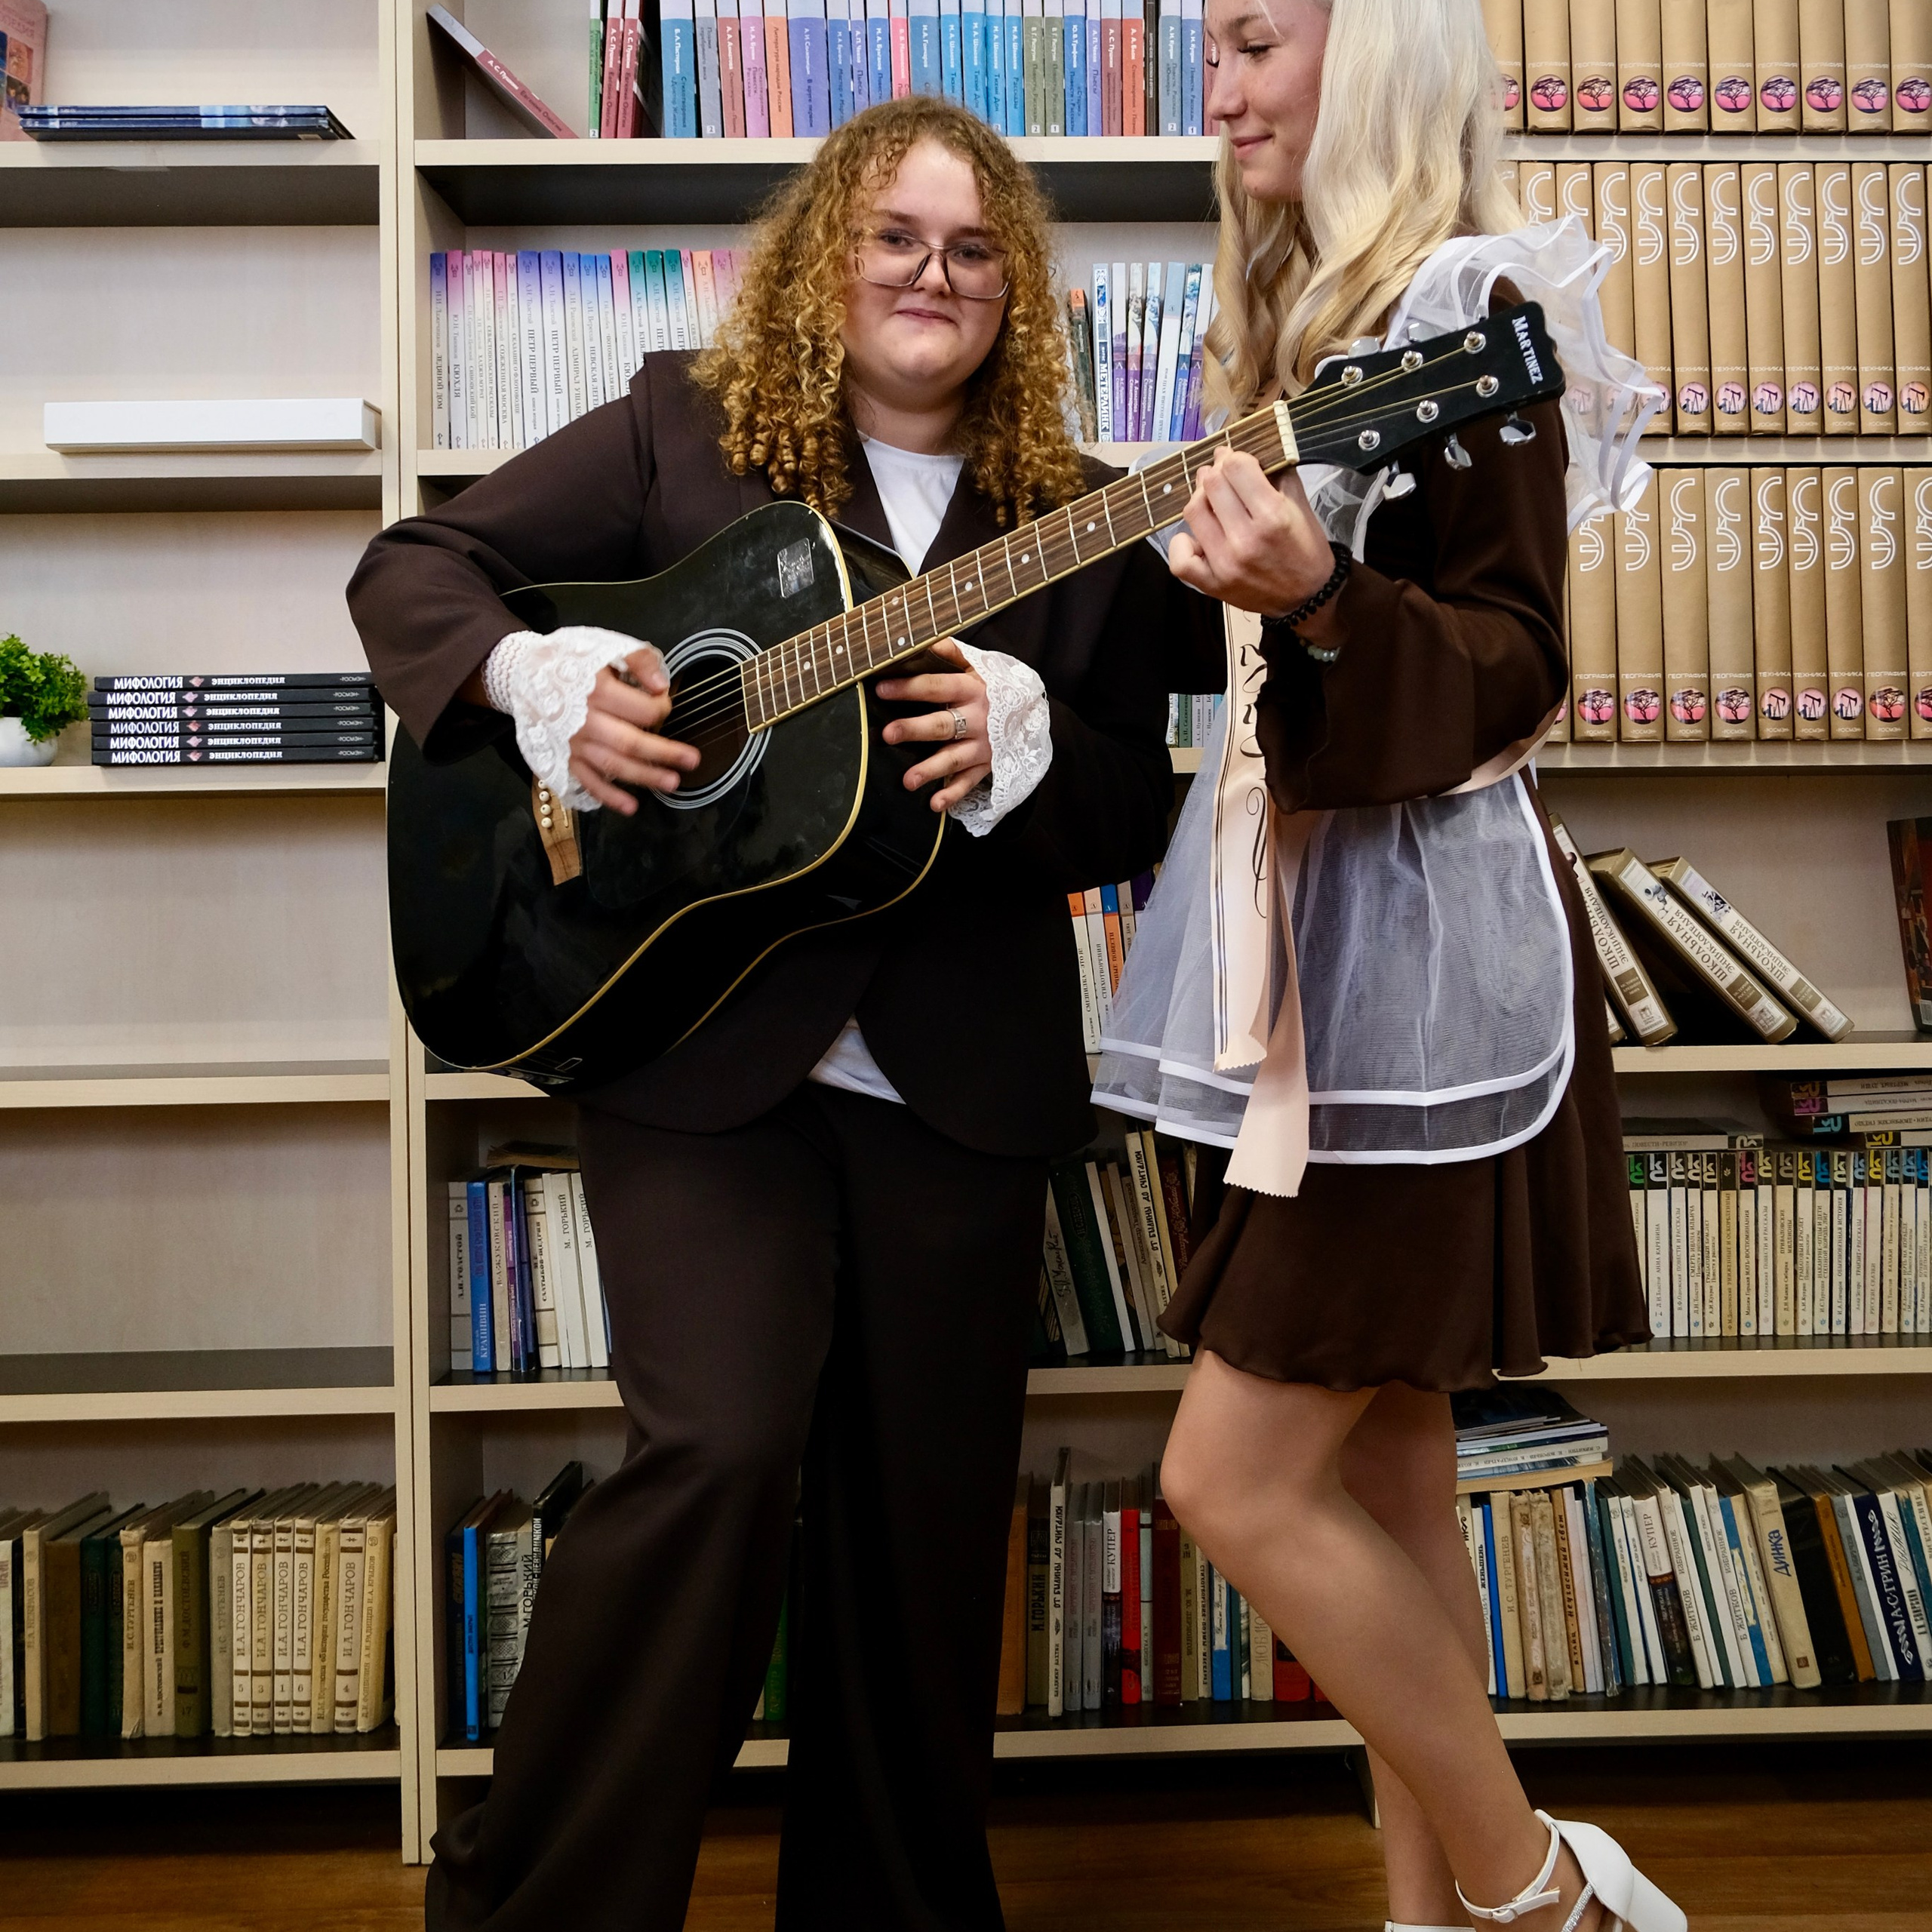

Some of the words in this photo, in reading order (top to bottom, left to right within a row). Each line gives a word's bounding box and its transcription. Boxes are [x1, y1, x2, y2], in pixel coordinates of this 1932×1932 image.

[528, 329, 537, 352] ПЕТР
[551, 330, 560, 353] ПЕТР
[1512, 315, 1543, 385] MARTINEZ
[453, 364, 461, 398] КЮХЛЯ
[499, 344, 507, 392] СОЖЖЕННАЯ
[528, 354, 538, 394] ПЕРВЫЙ
[552, 355, 563, 394] ПЕРВЫЙ
[572, 346, 580, 384] АДМИРАЛ
[589, 346, 598, 383] НЕВСКАЯ
[1100, 363, 1109, 429] МЕТЕРЛИНК
[106, 692, 176, 704] МИФОЛОГИЯ
[204, 692, 278, 701] ЭНЦИКЛОПЕДИЯ
[114, 677, 183, 690] МИФОЛОГИЯ
[211, 677, 285, 685] ЭНЦИКЛОПЕДИЯ
[108, 708, 177, 719] МИФОЛОГИЯ
[206, 707, 280, 715] ЭНЦИКЛОПЕДИЯ
[110, 721, 180, 734] МИФОЛОГИЯ
[208, 721, 281, 730] ЭНЦИКЛОПЕДИЯ
[109, 737, 179, 749] МИФОЛОГИЯ
[208, 737, 281, 746] ЭНЦИКЛОПЕДИЯ
[111, 751, 180, 764] МИФОЛОГИЯ
[209, 751, 283, 759] ЭНЦИКЛОПЕДИЯ
[1584, 886, 1629, 964] ЭНЦИКЛОПЕДИЯ
[1674, 909, 1736, 974] ЭНЦИКЛОПЕДИЯ
[1109, 931, 1118, 961] ПОВЕСТИ
[1667, 915, 1728, 983] ШКОЛЬНАЯ
[1728, 925, 1786, 982] ШКОЛЬНАЯ
[1734, 918, 1791, 974] ЭНЦИКЛОПЕДИЯ
[1096, 943, 1107, 998] СТИХОТВОРЕНИЯ
[1135, 1150, 1149, 1189] СЧИТАЛКИ
[558, 1194, 570, 1234] ГОРЬКИЙ
[1125, 1182, 1140, 1226] Твардовский
[1142, 1192, 1150, 1201] ДО
[1145, 1206, 1157, 1238] БЫЛИНЫ
[1135, 1227, 1147, 1265] Александр
[1150, 1240, 1159, 1251] ОТ
[479, 1303, 488, 1358] КРАПИВИН
[1054, 1506, 1063, 1544] СЧИТАЛКИ
[1643, 1514, 1658, 1549] КУПЕР
[1054, 1548, 1062, 1558] ДО
[1106, 1528, 1117, 1565] КУПЕР
[1501, 1535, 1513, 1589] ТУРГЕНЕВ
[1670, 1530, 1684, 1574] ИЗБРАННОЕ
[1716, 1529, 1731, 1574] ИЗБРАННОЕ
[1054, 1562, 1062, 1595] БЫЛИНЫ
[1478, 1544, 1486, 1589] ЖЕНЬШЕНЬ
[235, 1562, 245, 1630] ГОНЧАРОВ
[257, 1563, 266, 1630] ГОНЧАРОВ
[278, 1561, 288, 1629] ГОНЧАРОВ
[297, 1562, 307, 1630] ГОНЧАРОВ
[344, 1562, 355, 1630] ГОНЧАРОВ
[1053, 1598, 1061, 1608] ОТ
[1683, 1589, 1698, 1631] ЖИТКОВ
[1729, 1589, 1746, 1630] ЖИТКОВ
